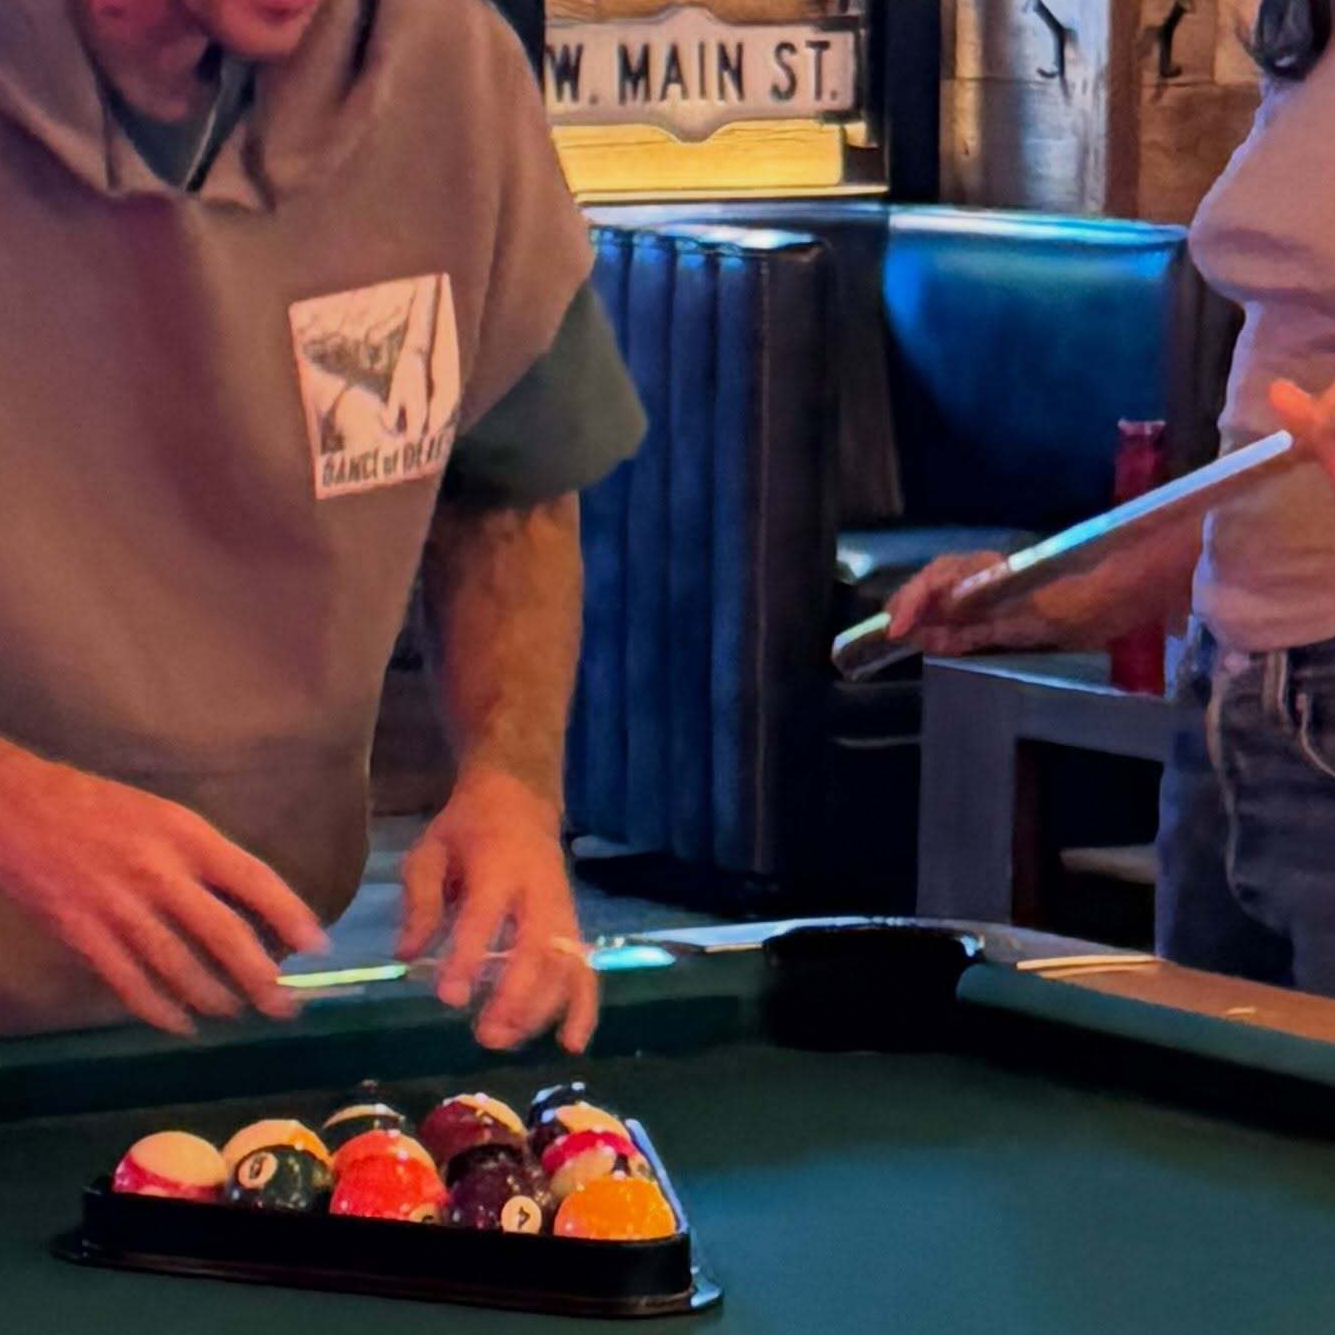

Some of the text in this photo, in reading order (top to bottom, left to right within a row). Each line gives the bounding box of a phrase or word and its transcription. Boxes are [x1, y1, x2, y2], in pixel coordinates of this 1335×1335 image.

[544, 38, 838, 106] W. MAIN ST.
